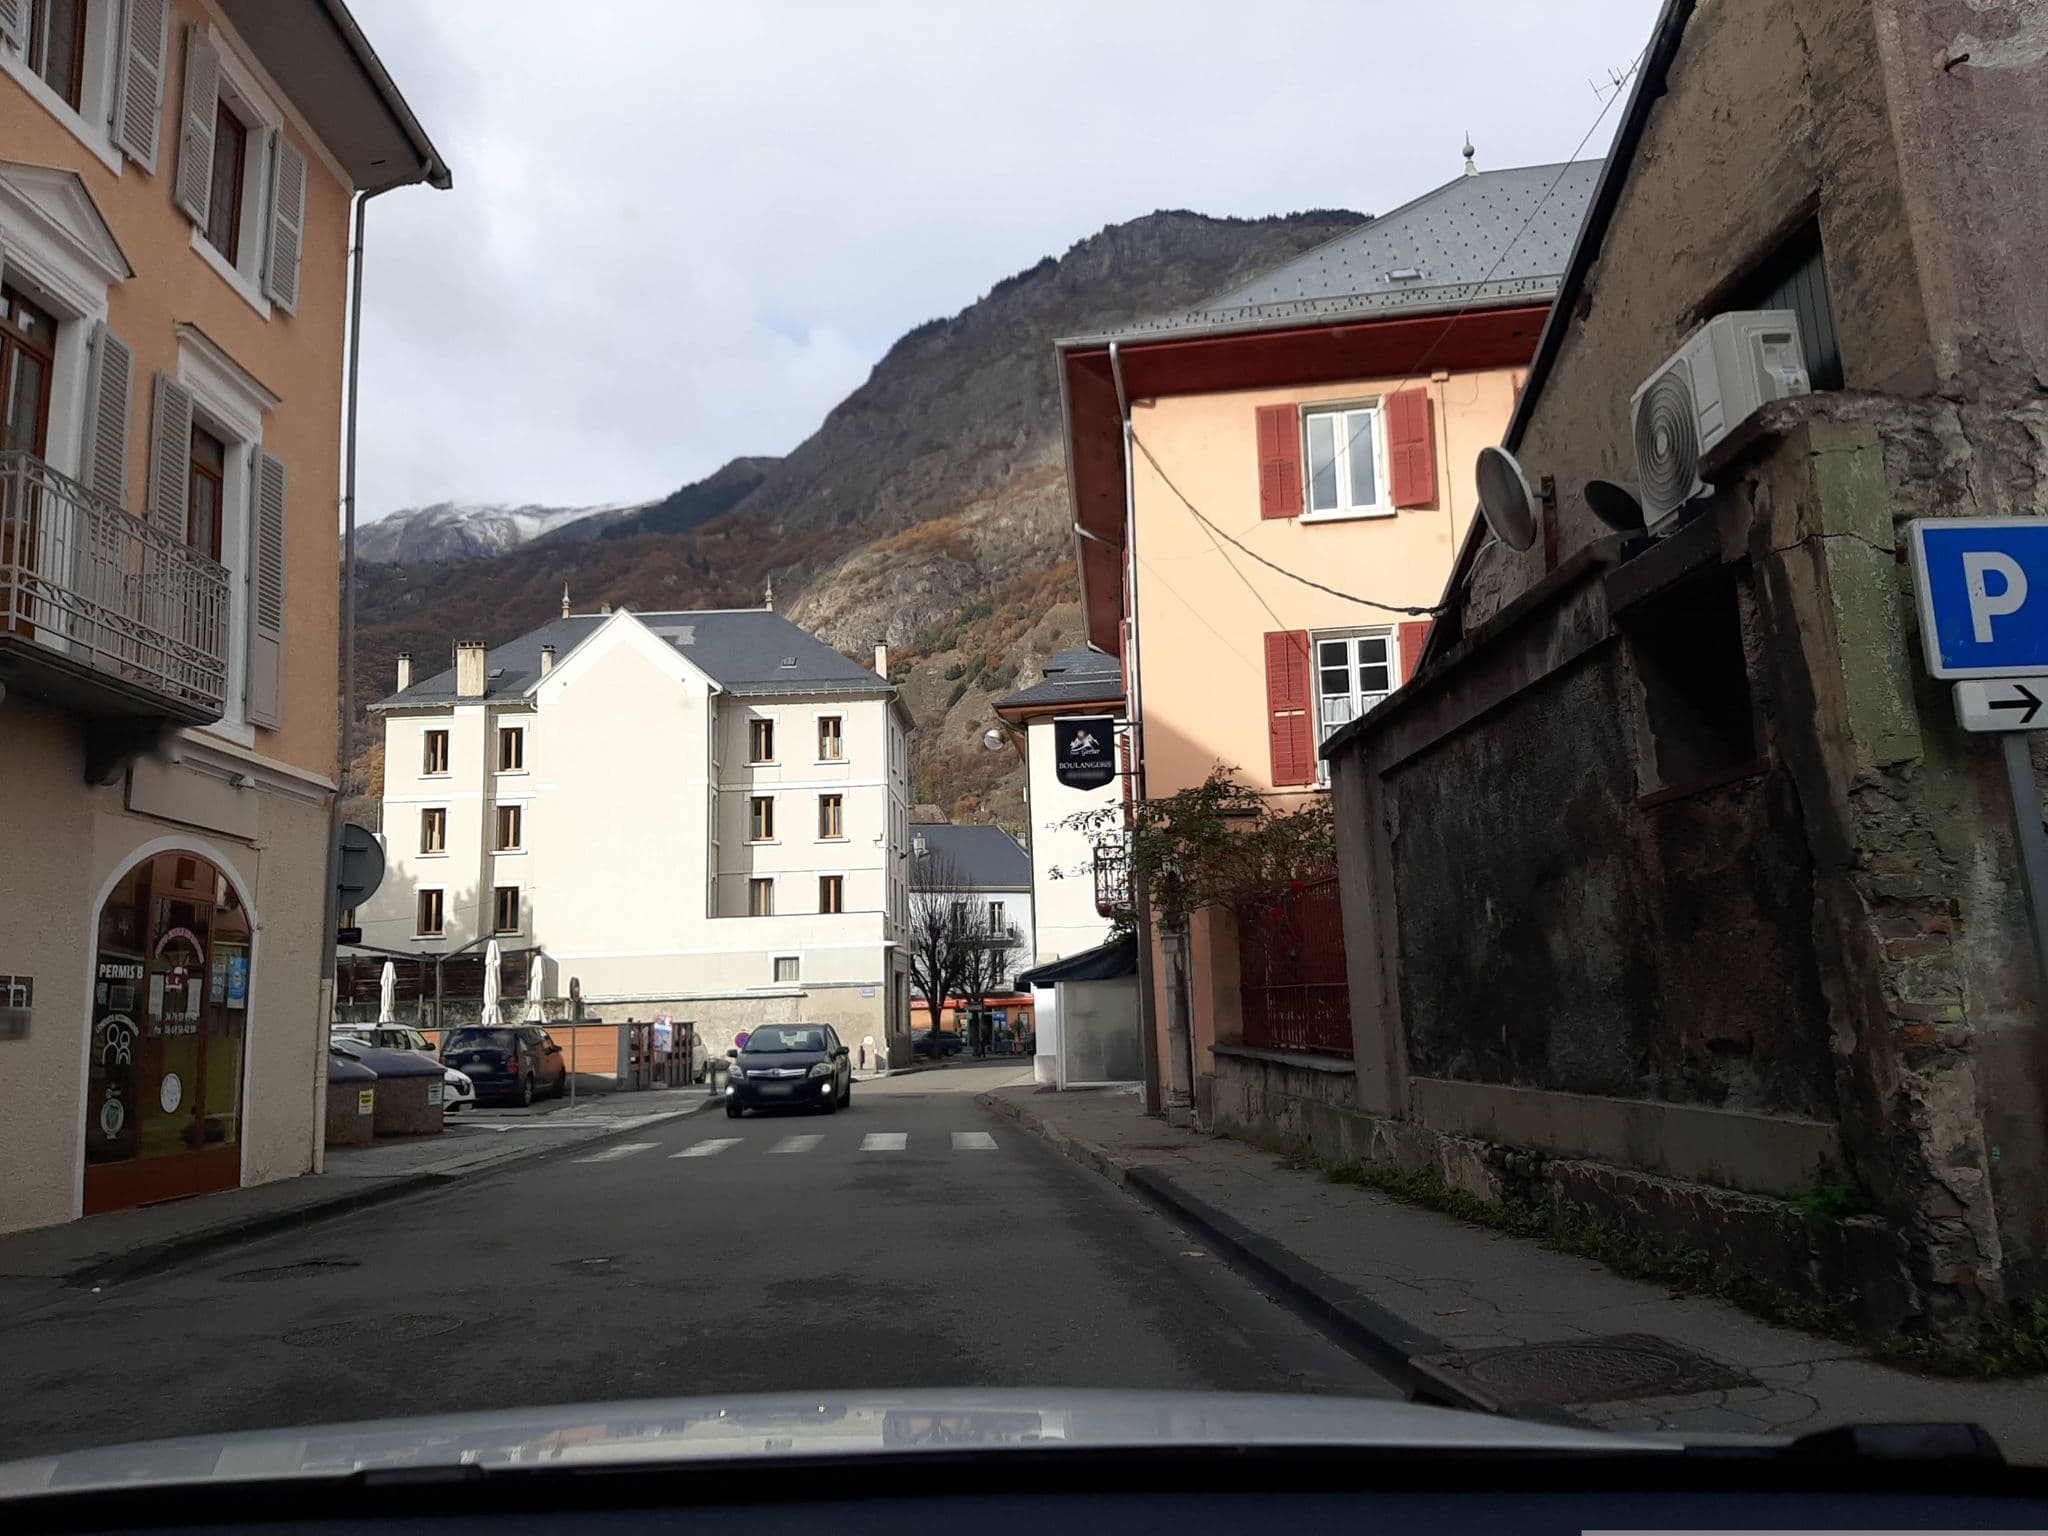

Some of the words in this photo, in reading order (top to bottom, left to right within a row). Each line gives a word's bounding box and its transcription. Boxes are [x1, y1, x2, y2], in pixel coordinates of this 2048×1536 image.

[1962, 551, 2028, 643] P
[1059, 760, 1111, 769] BOULANGERIE
[99, 963, 135, 979] PERMIS
[136, 966, 144, 979] B
